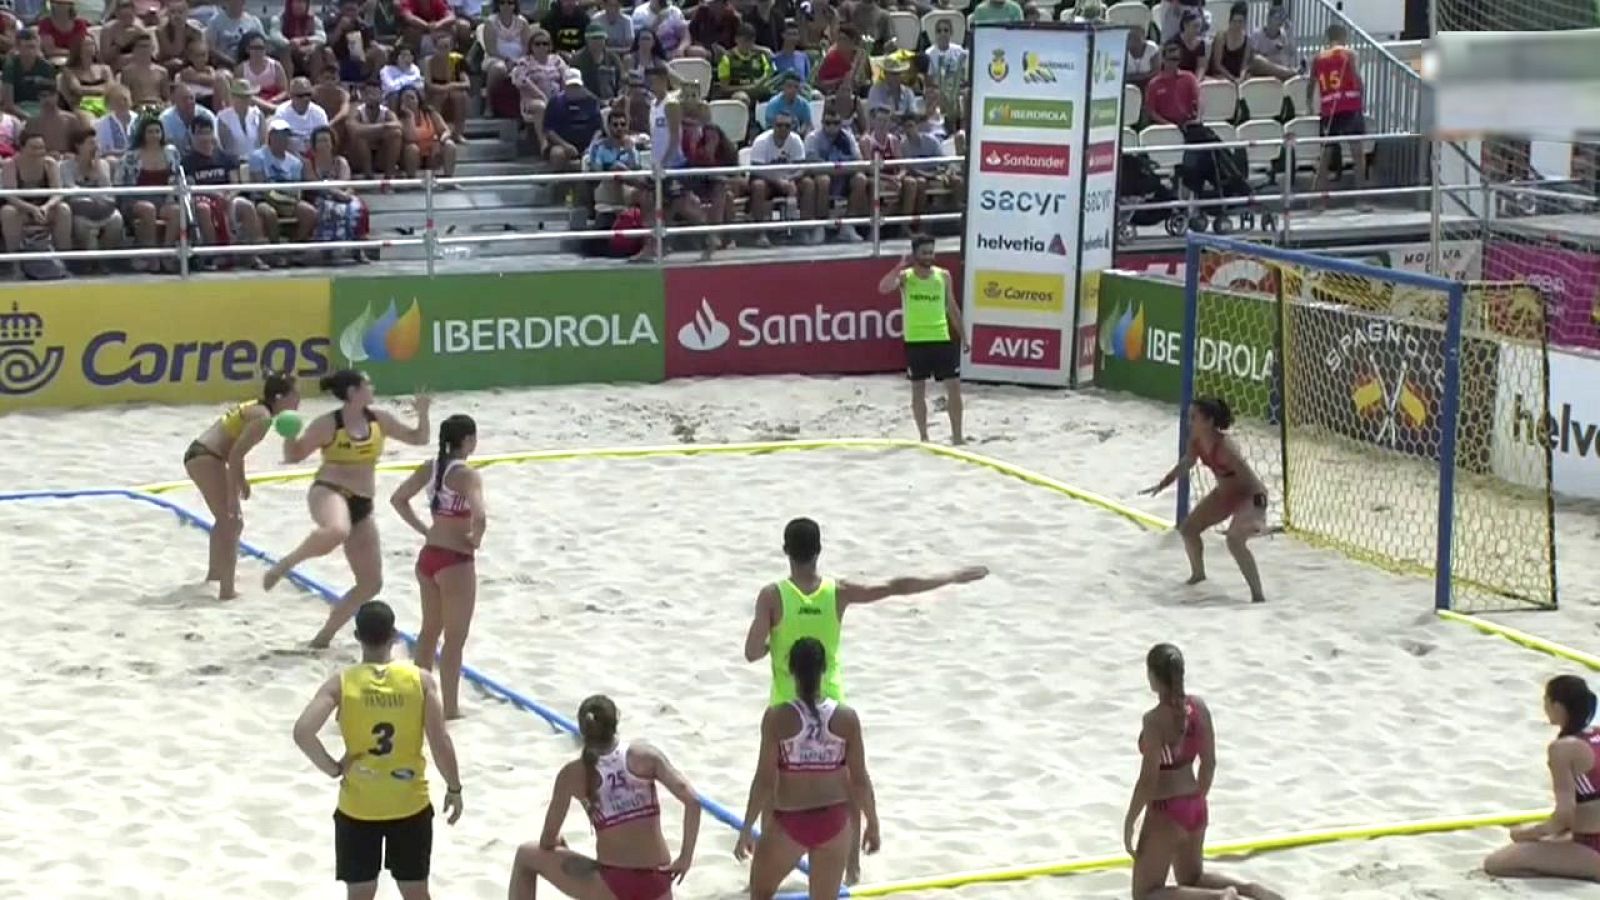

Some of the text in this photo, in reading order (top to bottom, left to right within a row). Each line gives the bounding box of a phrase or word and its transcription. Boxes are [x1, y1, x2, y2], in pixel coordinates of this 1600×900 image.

[1010, 108, 1067, 121] IBERDROLA
[1003, 153, 1066, 169] Santander
[980, 189, 1067, 216] sacyr
[976, 233, 1046, 252] helvetia
[1004, 287, 1054, 302] Correos
[432, 312, 659, 353] IBERDROLA
[81, 330, 331, 387] Correos
[989, 336, 1045, 360] AVIS
[367, 721, 396, 757] 3
[607, 768, 628, 793] 25
